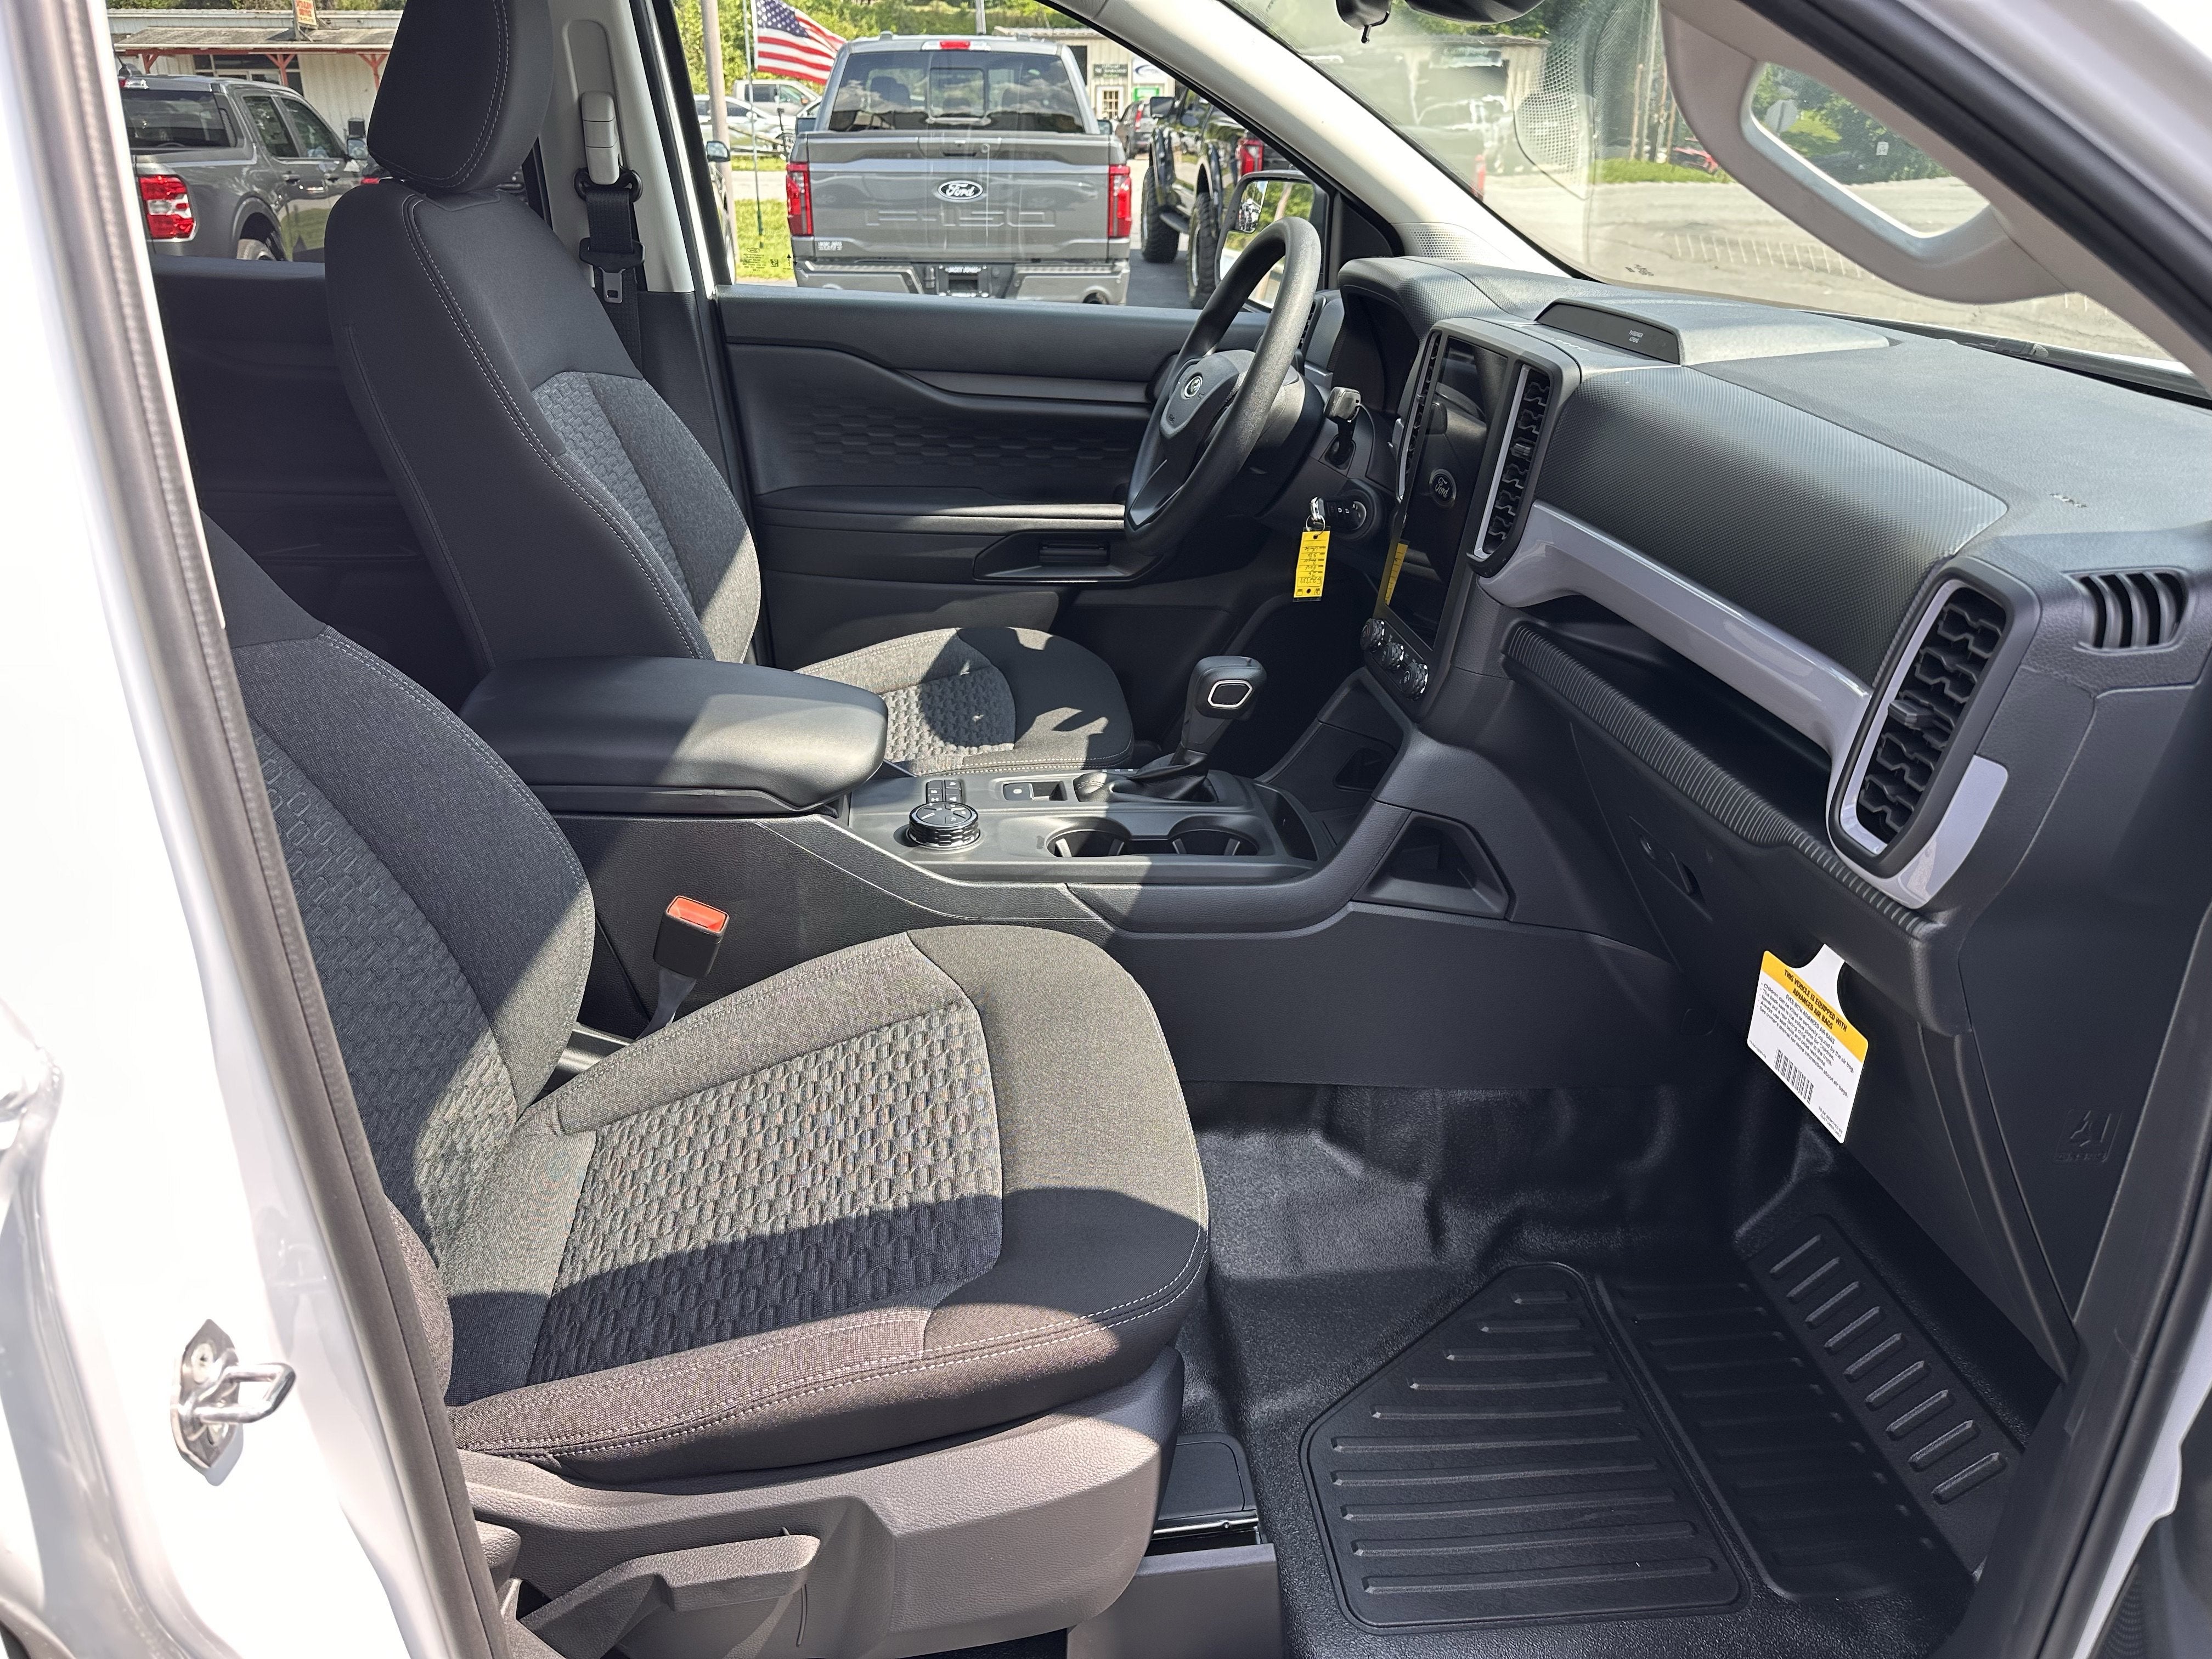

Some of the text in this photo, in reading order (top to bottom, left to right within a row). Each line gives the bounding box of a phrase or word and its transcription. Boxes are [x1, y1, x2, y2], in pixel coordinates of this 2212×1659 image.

[945, 183, 975, 196] Ford
[865, 210, 1057, 227] F-150
[1435, 477, 1450, 498] Ford
[1784, 969, 1847, 1032] THIS VEHICLE IS EQUIPPED WITH
[1792, 986, 1833, 1030] ADVANCED AIR BAGS
